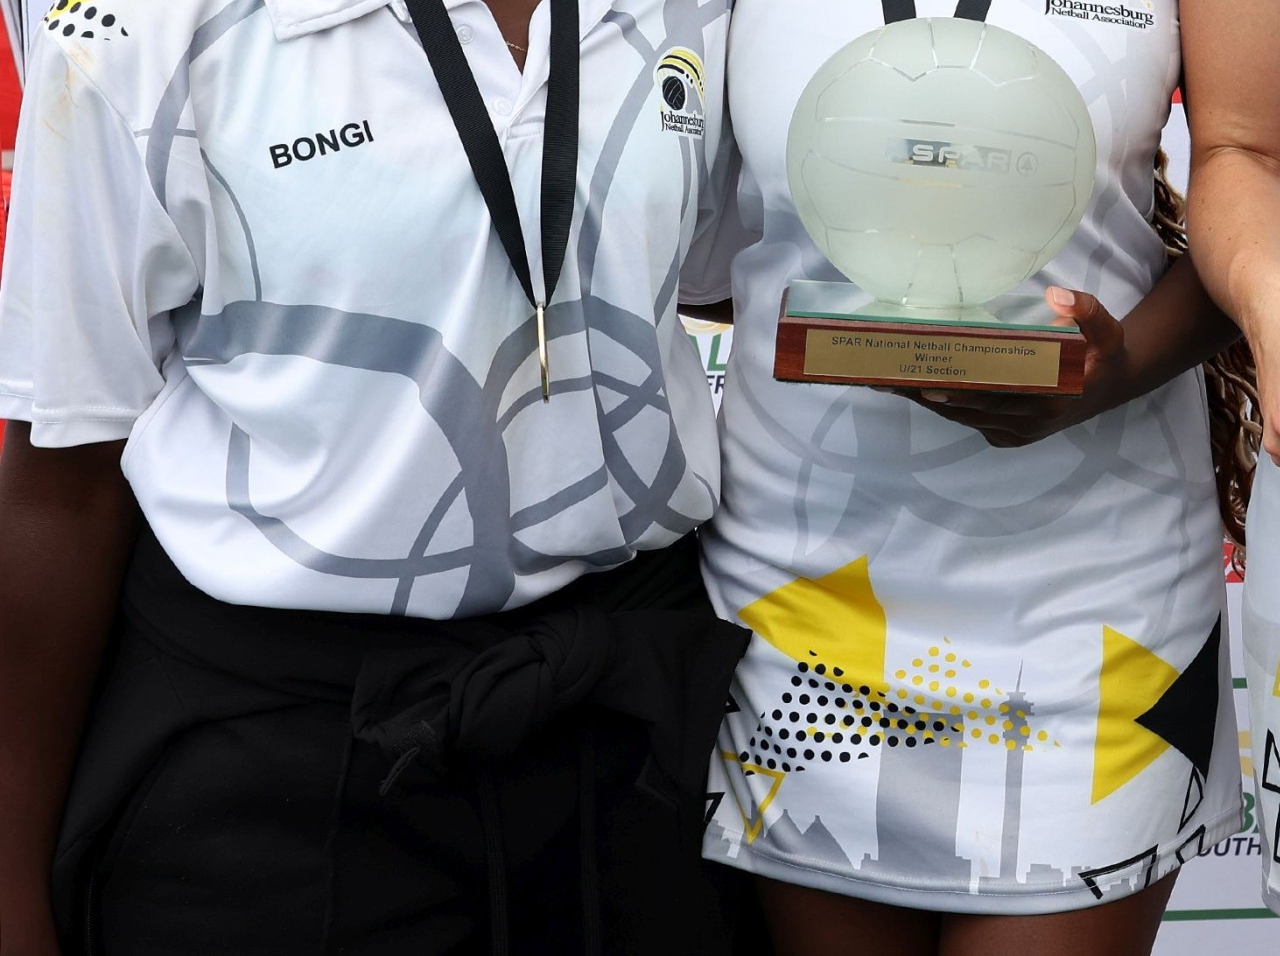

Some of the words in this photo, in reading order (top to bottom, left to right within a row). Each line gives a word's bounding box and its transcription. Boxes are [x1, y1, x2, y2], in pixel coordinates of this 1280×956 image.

[1051, 7, 1089, 20] Netball
[1092, 13, 1146, 29] Association
[269, 120, 374, 169] BONGI
[912, 143, 1008, 171] SPAR
[832, 336, 862, 347] SPAR
[865, 337, 911, 349] National
[913, 340, 951, 351] Netball
[954, 342, 1036, 356] Championships
[915, 352, 953, 364] Winner
[899, 363, 923, 375] U/21
[926, 365, 967, 377] Section
